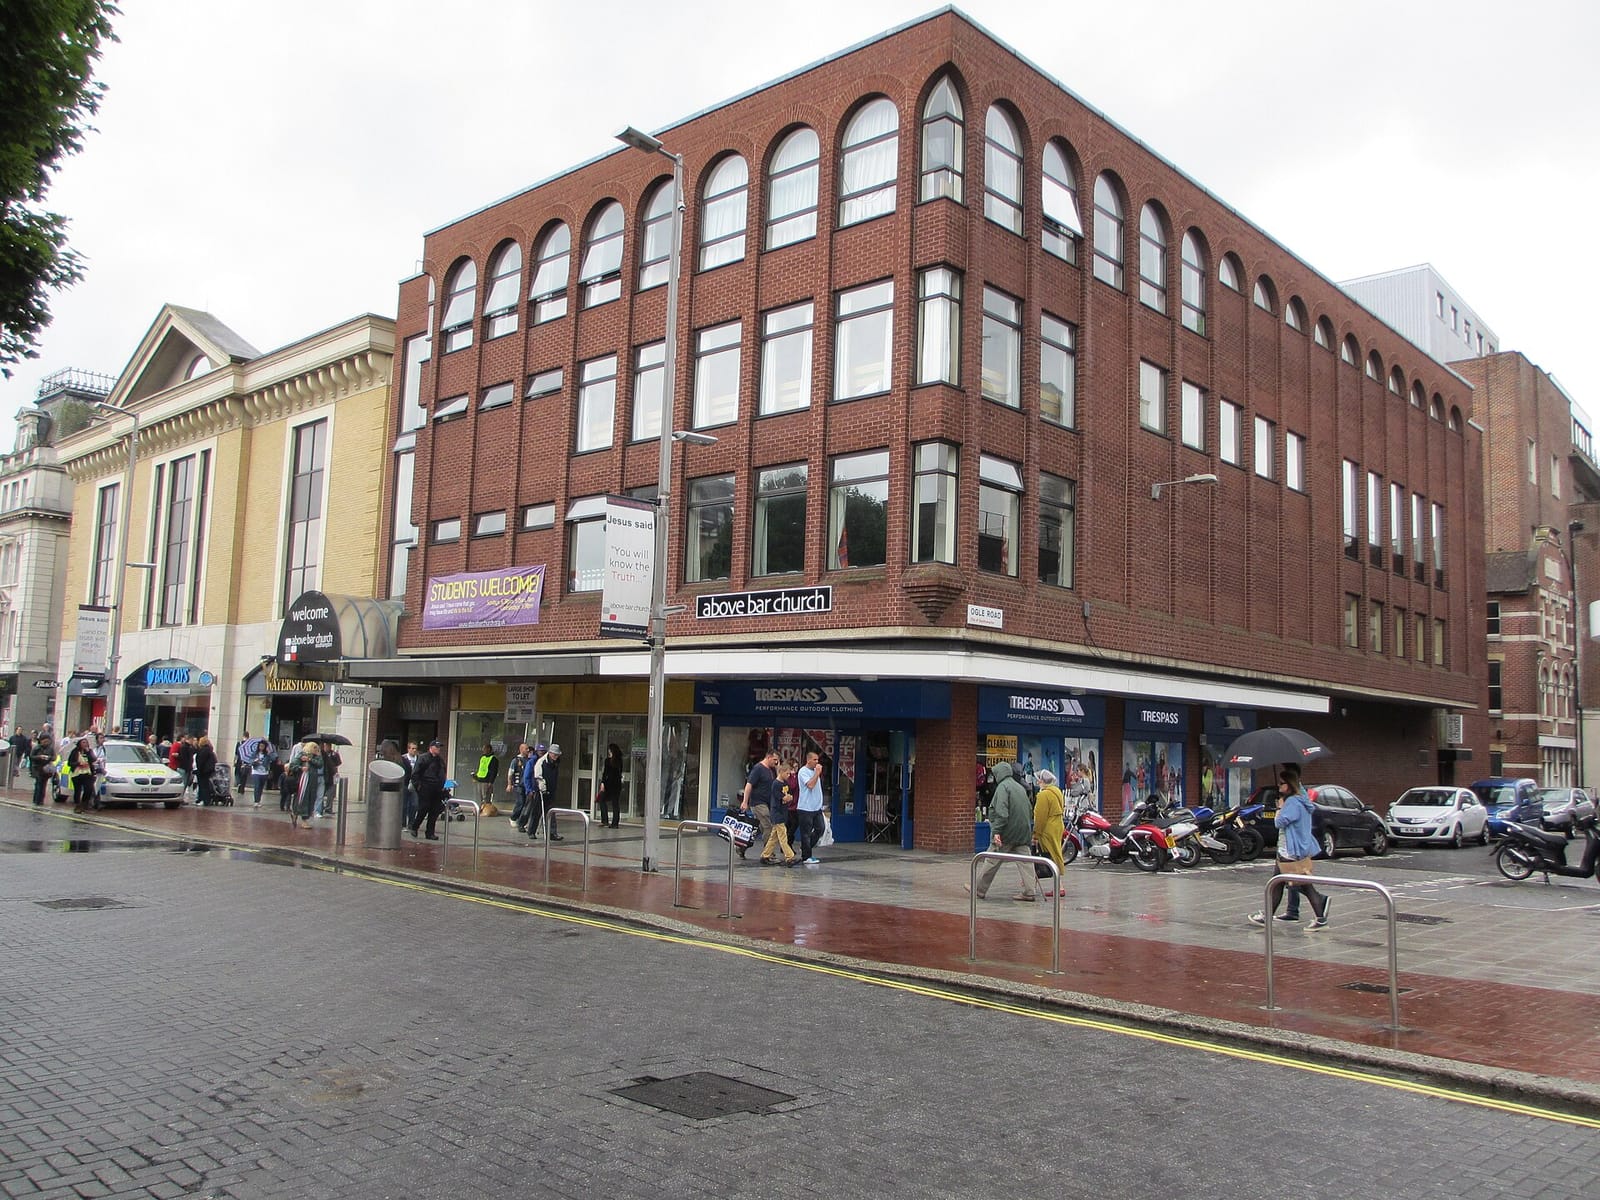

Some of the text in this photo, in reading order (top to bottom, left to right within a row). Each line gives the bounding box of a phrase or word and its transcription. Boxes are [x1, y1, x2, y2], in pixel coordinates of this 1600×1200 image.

[607, 515, 653, 530] Jesus said
[633, 549, 649, 560] will
[610, 557, 650, 571] know the
[430, 574, 540, 602] STUDENTS WELCOME!
[703, 589, 825, 617] above bar church
[292, 605, 329, 621] welcome
[970, 607, 1002, 620] OGLE ROAD
[306, 623, 313, 632] to
[291, 632, 333, 646] above bar church
[154, 667, 189, 684] BARCLAYS
[335, 688, 355, 697] above
[753, 688, 821, 702] TRESPASS
[335, 696, 365, 706] church
[1009, 696, 1059, 712] TRESPASS
[1141, 709, 1179, 725] TRESPASS
[987, 739, 1017, 749] CLEARANCE
